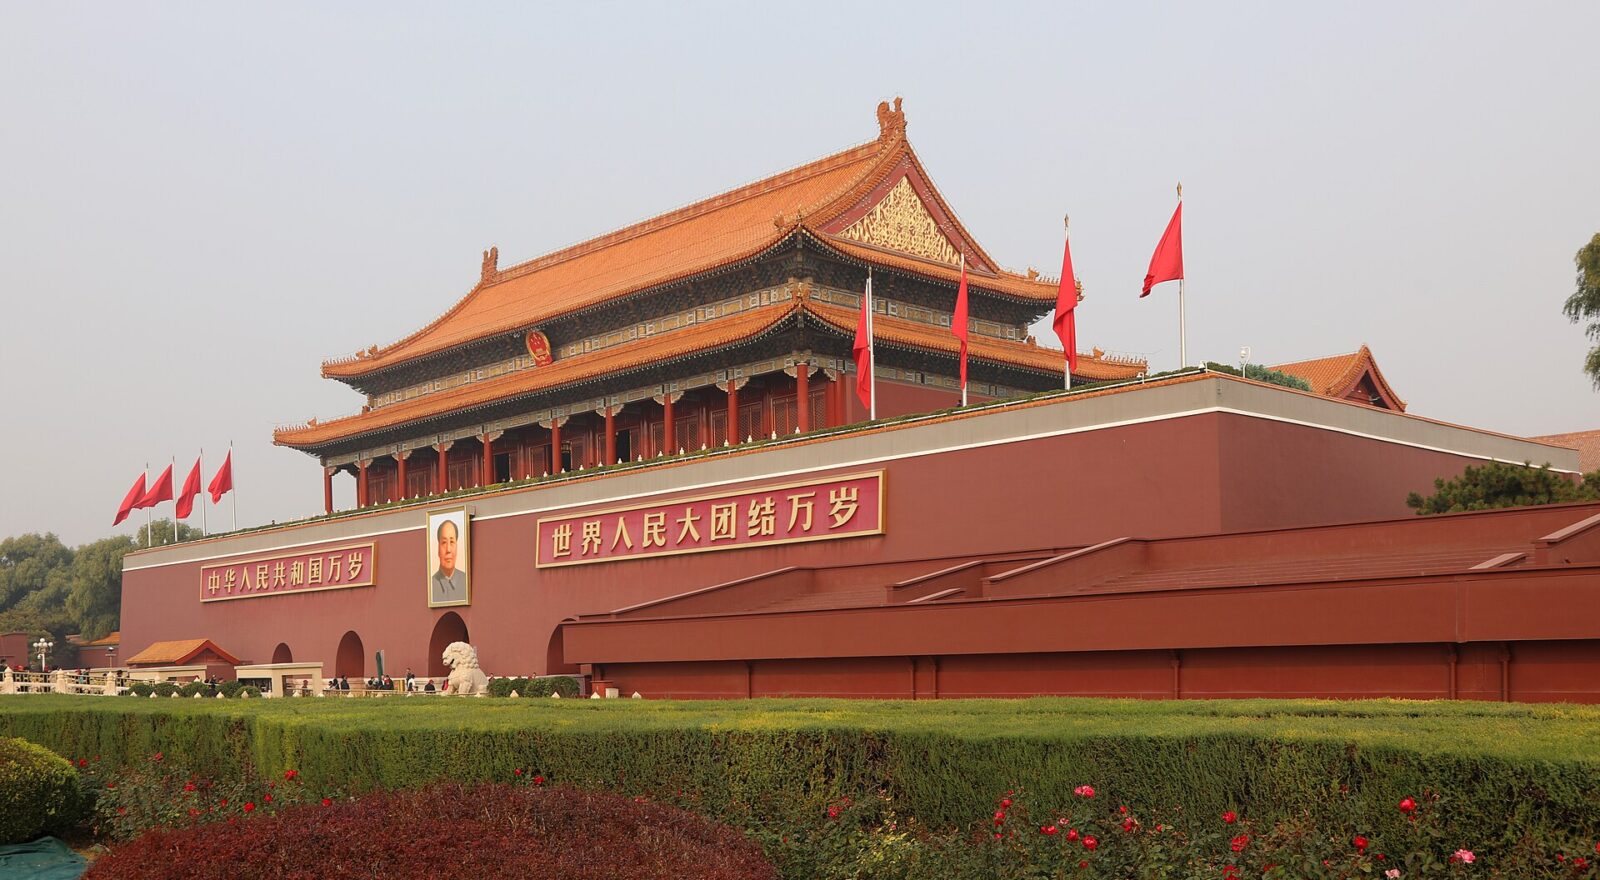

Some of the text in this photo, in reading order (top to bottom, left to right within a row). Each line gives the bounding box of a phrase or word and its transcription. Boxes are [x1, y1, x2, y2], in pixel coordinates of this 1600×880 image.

[551, 487, 860, 558] 世界人民大团结万岁
[208, 552, 363, 595] 中华人民共和国万岁
